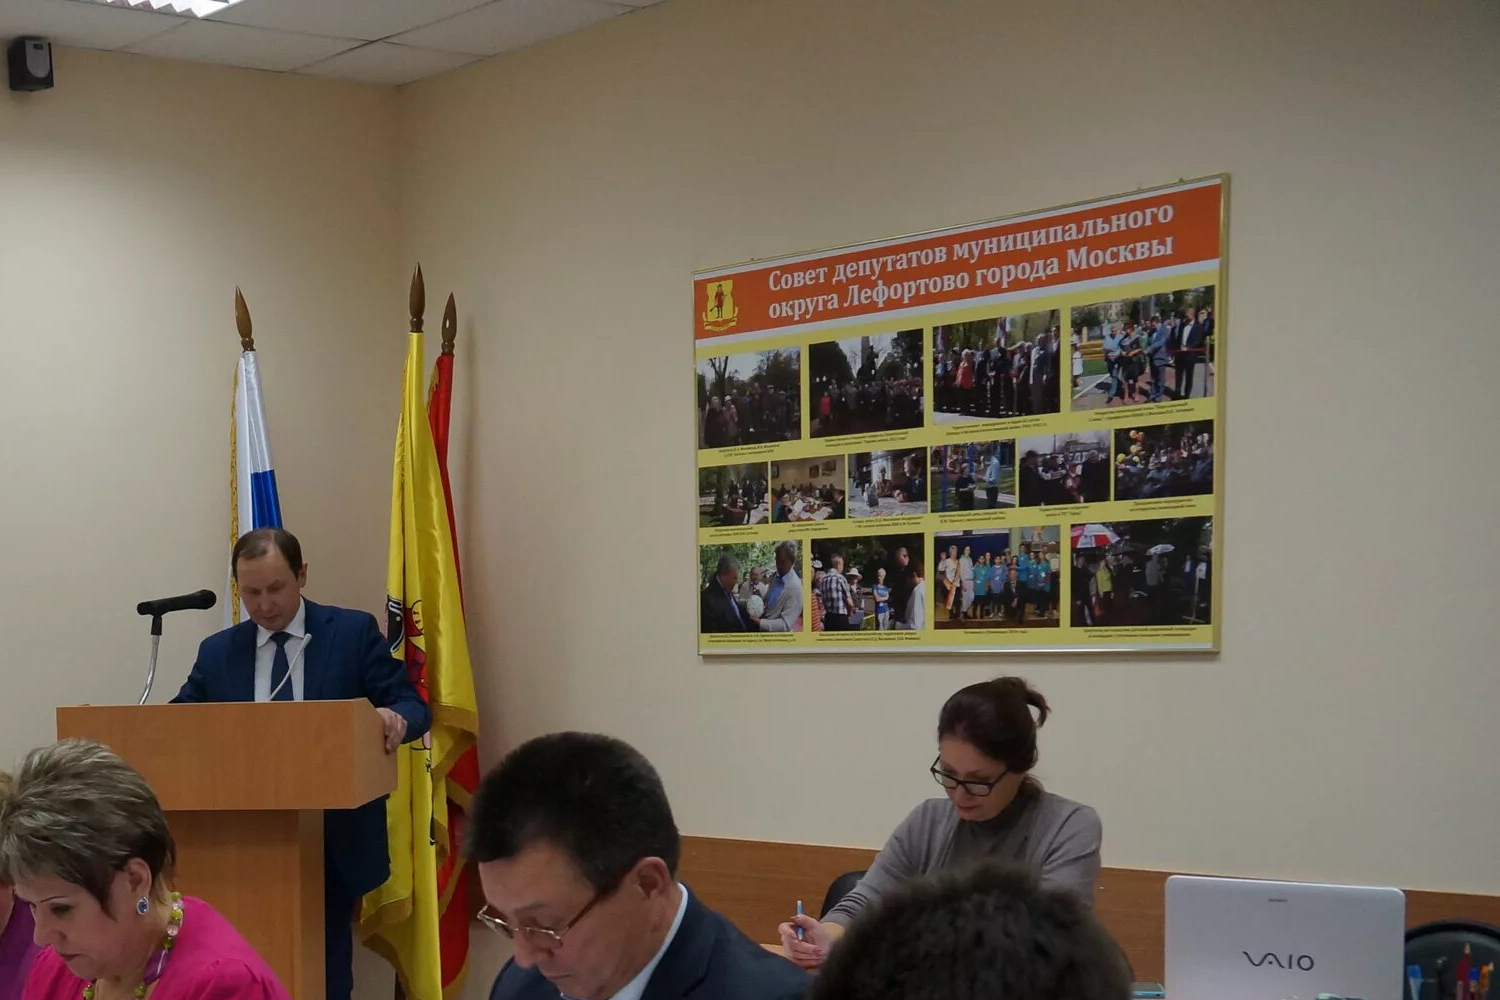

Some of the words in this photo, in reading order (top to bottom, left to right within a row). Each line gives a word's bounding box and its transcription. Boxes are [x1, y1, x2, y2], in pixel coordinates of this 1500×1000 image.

[768, 293, 839, 321] округа
[844, 272, 970, 308] Лефортово
[975, 257, 1060, 289] города
[1066, 236, 1173, 272] Москвы
[769, 267, 828, 291] Совет
[832, 246, 947, 285] депутатов
[953, 204, 1174, 263] муниципального
[1242, 951, 1315, 971] VAIO
